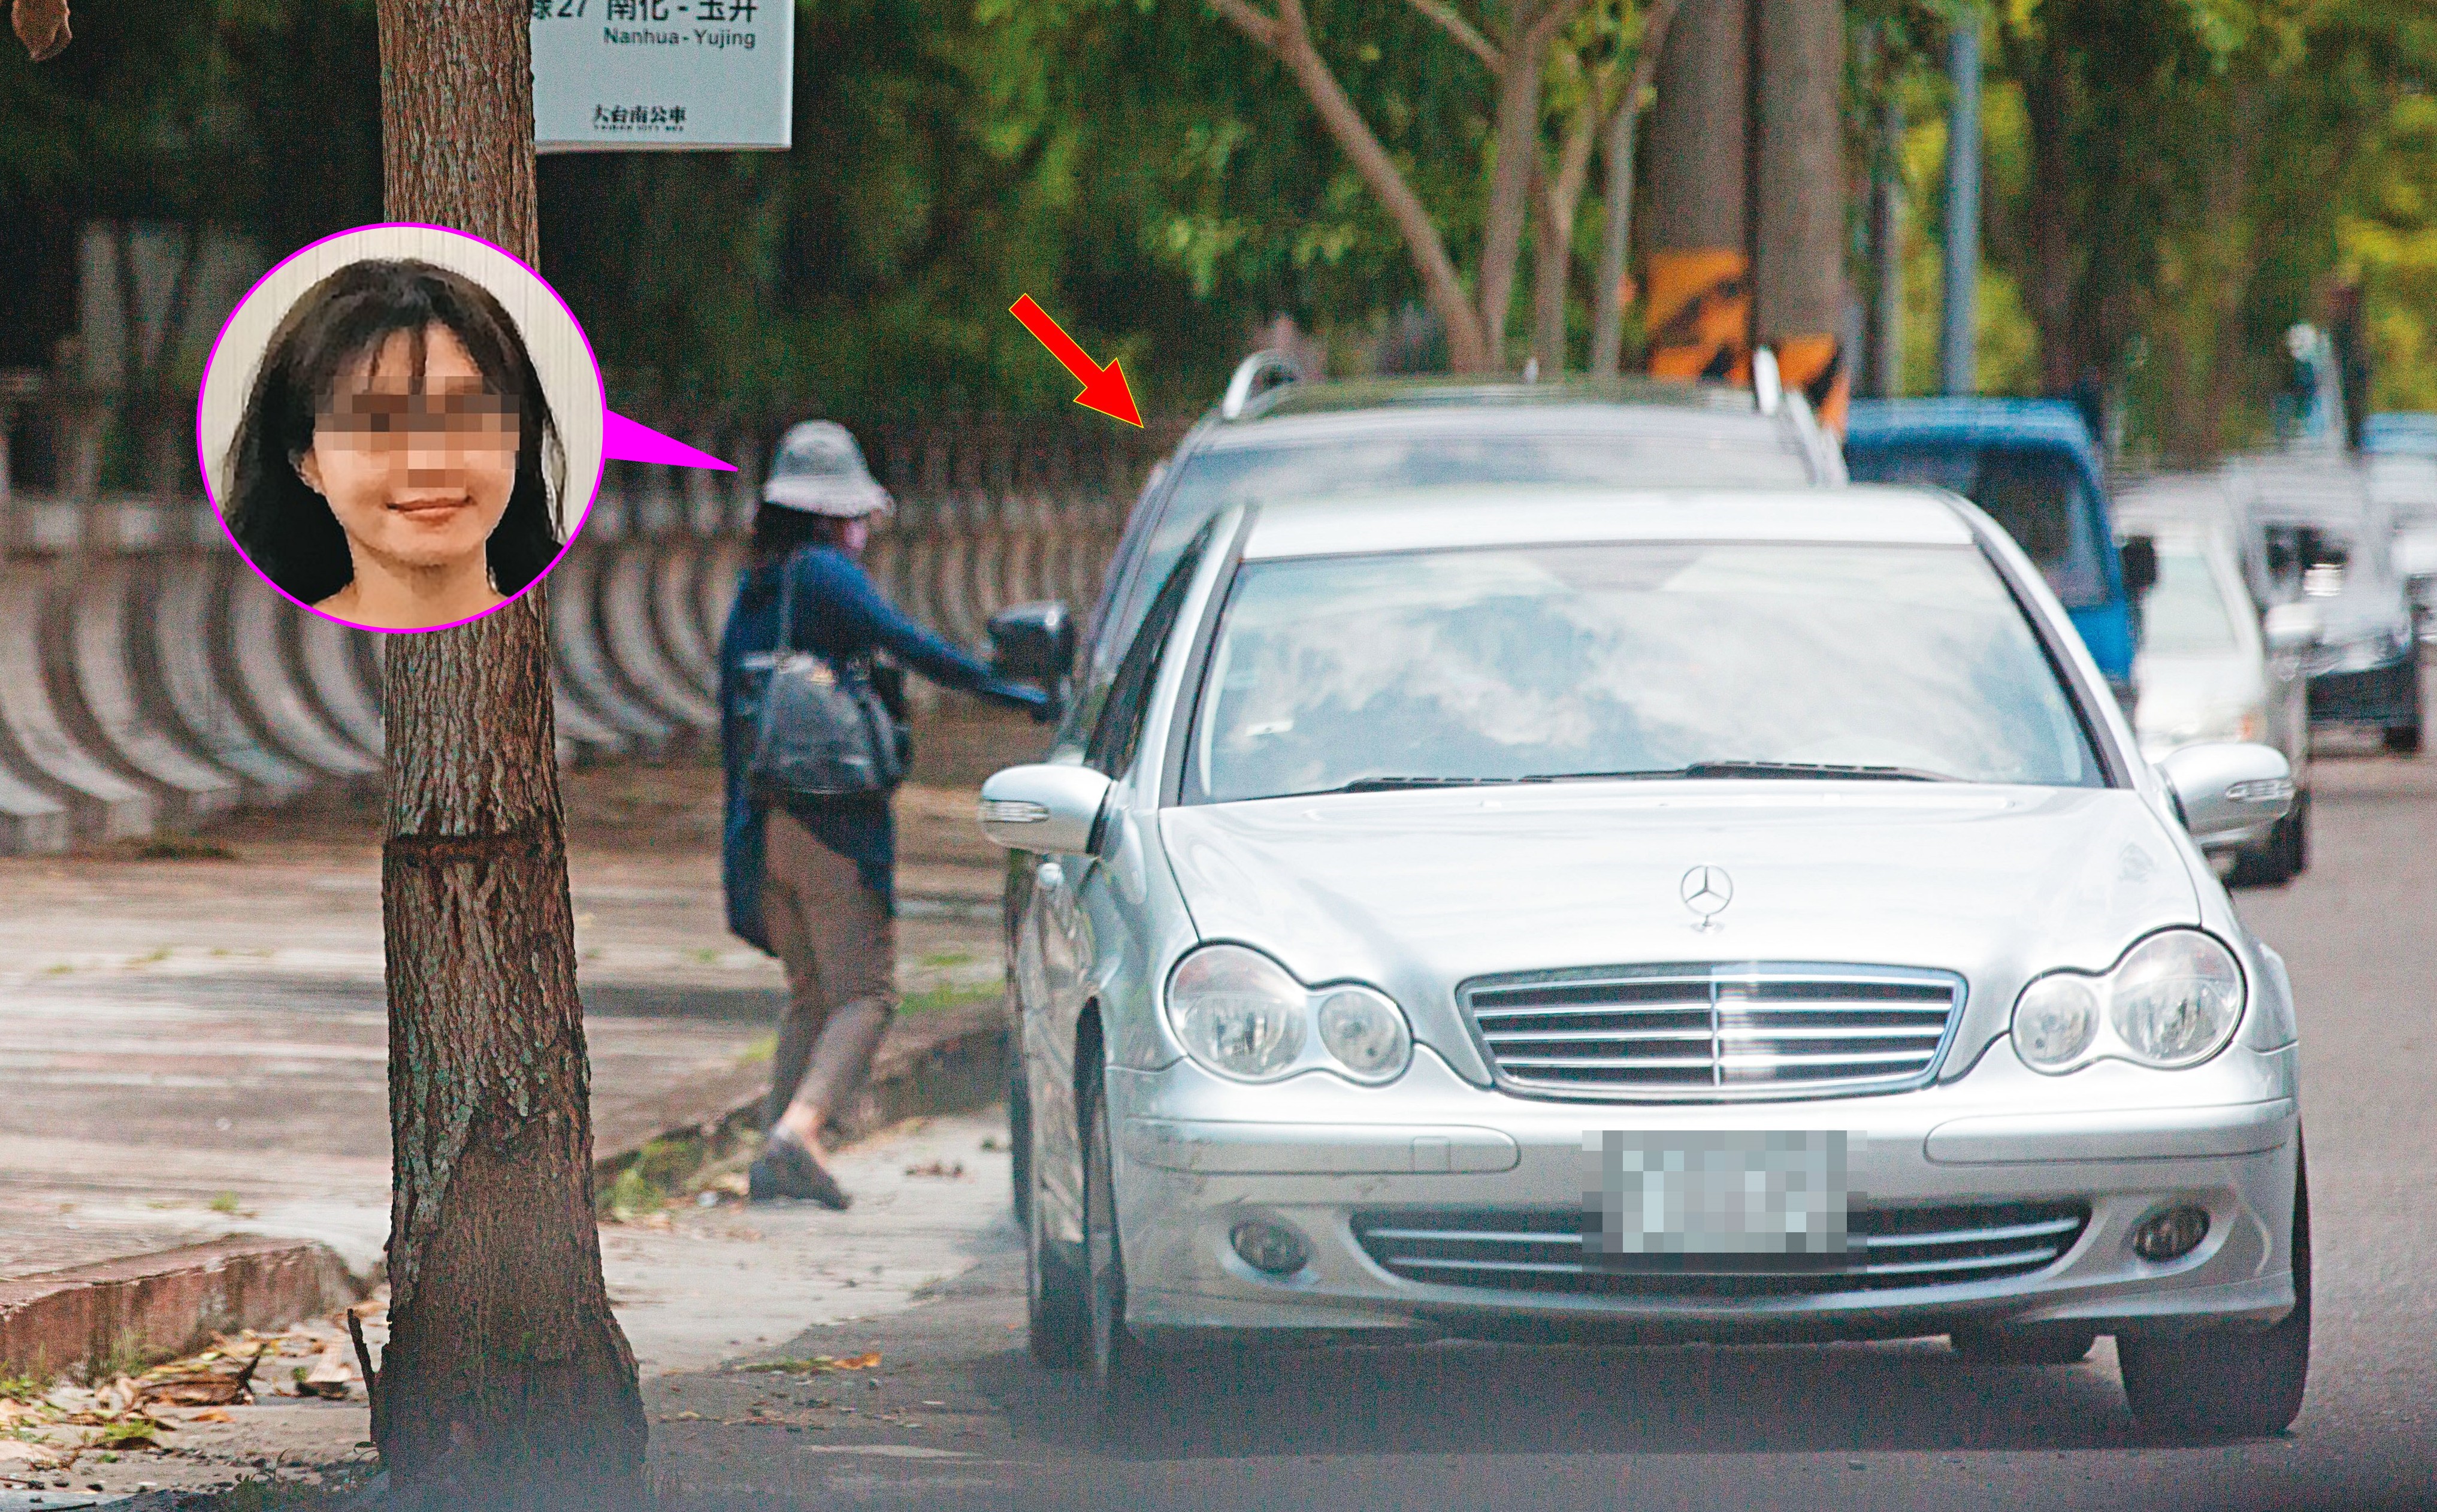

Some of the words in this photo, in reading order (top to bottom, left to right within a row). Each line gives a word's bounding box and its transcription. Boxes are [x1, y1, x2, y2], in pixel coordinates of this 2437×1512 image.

[593, 104, 686, 123] 大台南公車
